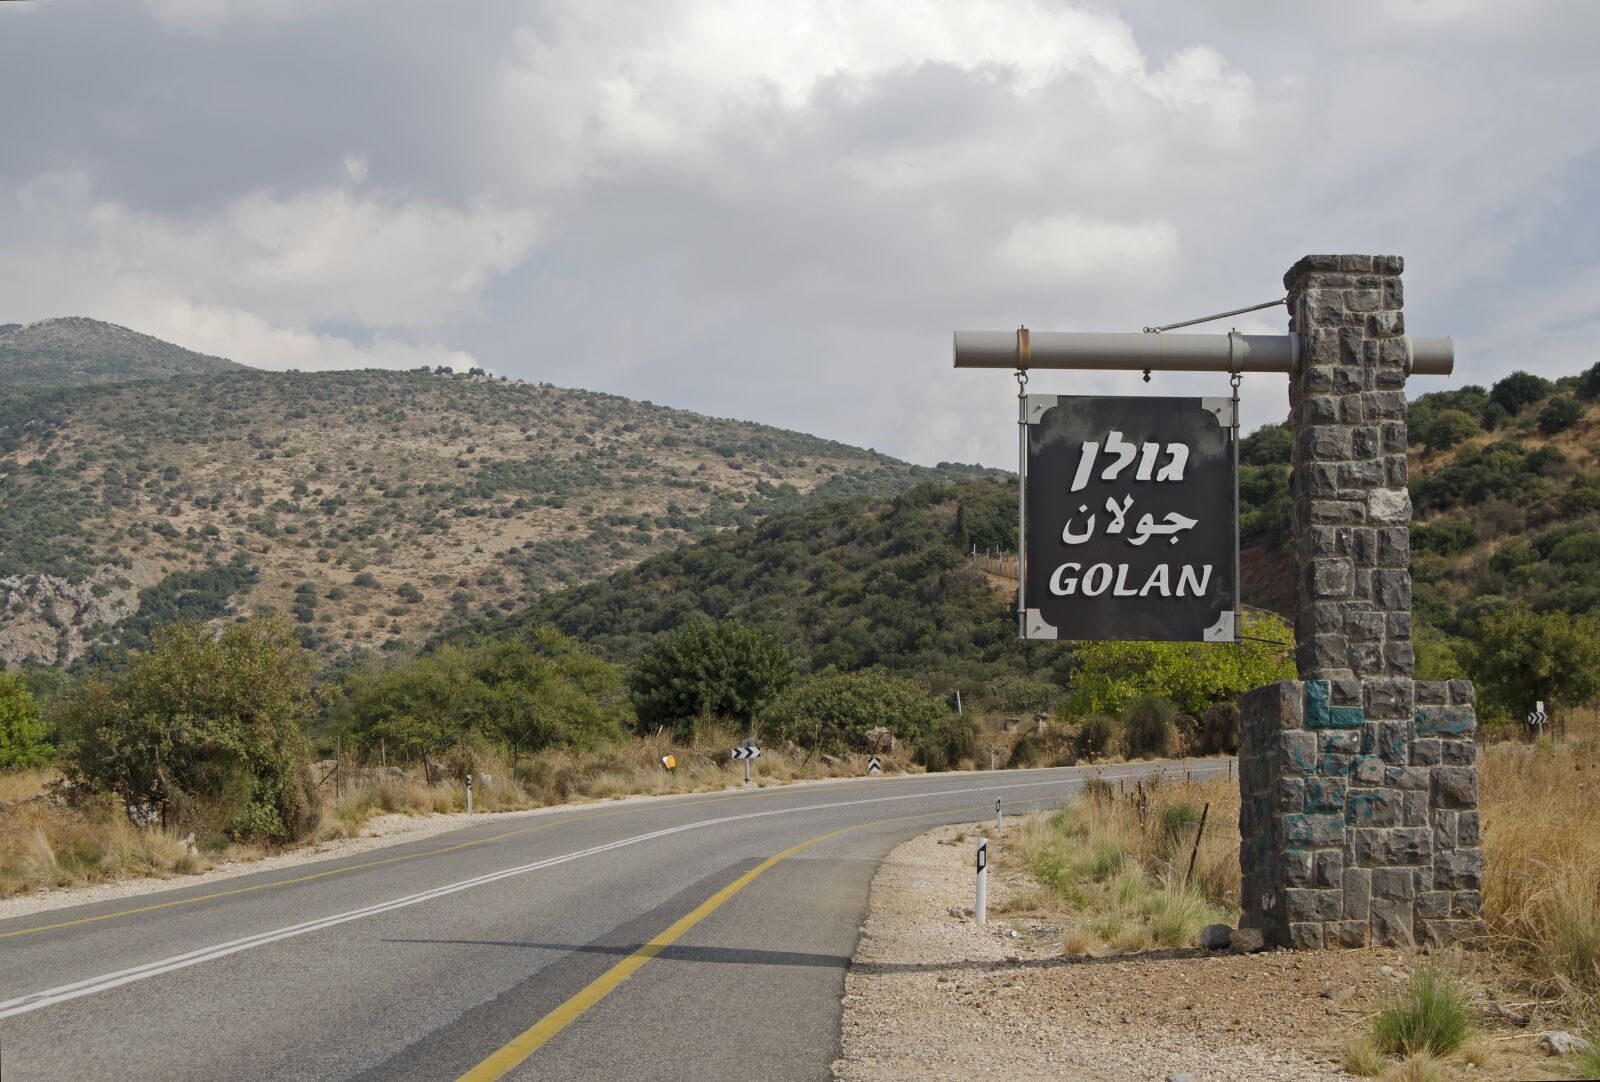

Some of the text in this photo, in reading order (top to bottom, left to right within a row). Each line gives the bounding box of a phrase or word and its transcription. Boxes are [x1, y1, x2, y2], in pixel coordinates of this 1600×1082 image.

[1070, 430, 1190, 492] גולן
[1062, 493, 1199, 546] جولان
[1049, 562, 1213, 597] GOLAN
